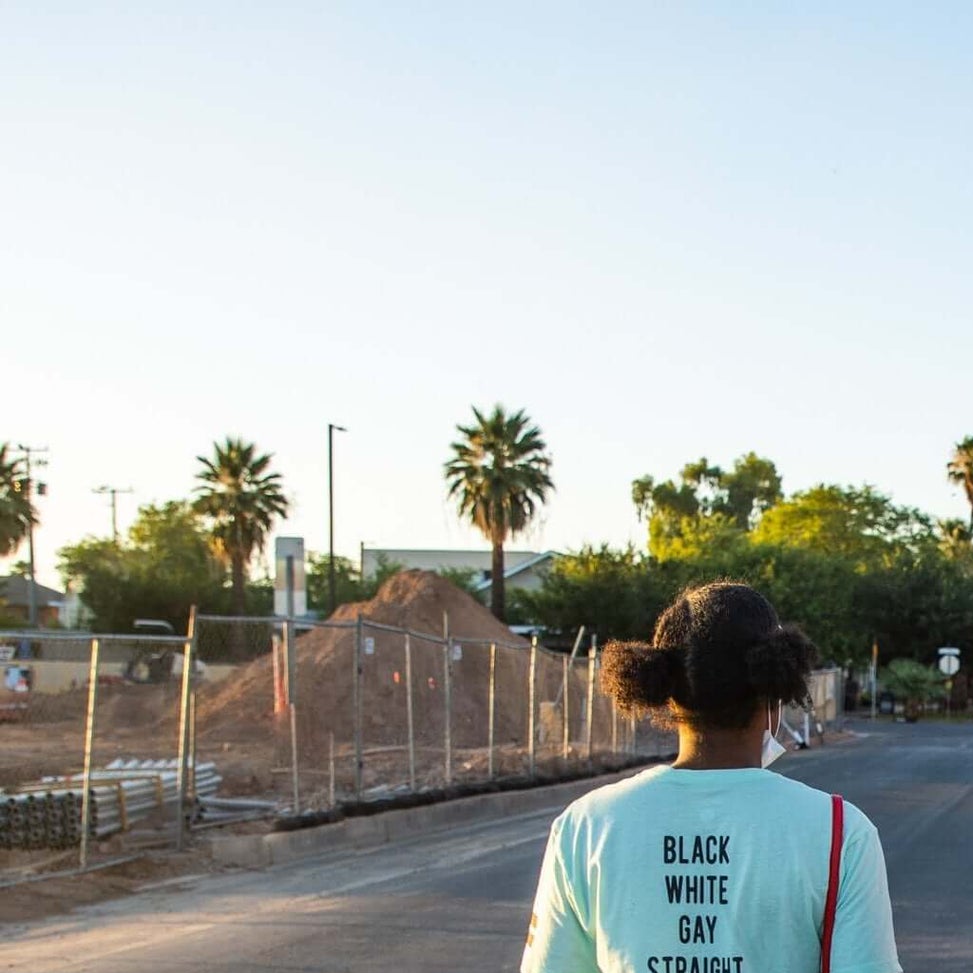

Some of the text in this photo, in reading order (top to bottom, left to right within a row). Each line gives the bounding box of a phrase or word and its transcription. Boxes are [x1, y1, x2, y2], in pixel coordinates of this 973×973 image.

[663, 835, 730, 864] BLACK
[665, 875, 729, 905] WHITE
[678, 915, 717, 944] GAY
